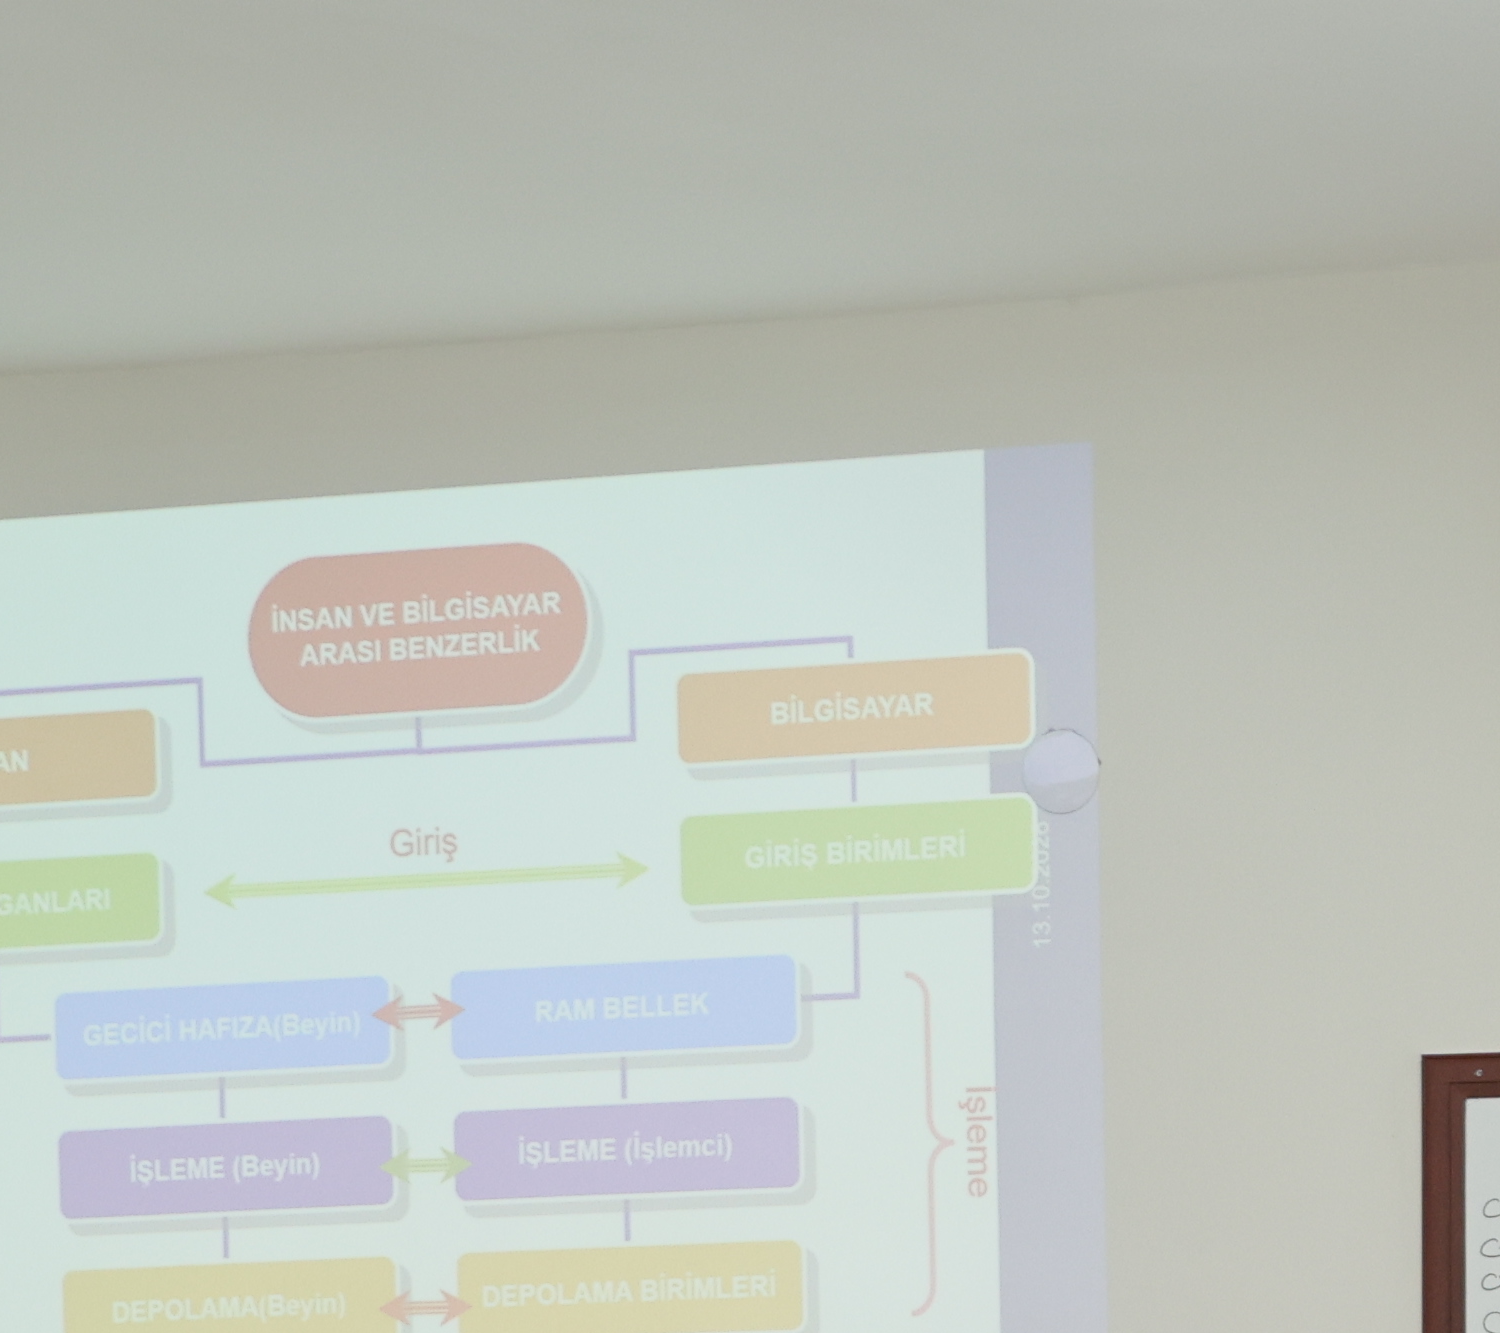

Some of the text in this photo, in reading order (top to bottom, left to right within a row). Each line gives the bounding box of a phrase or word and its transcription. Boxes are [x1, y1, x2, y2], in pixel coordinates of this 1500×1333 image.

[271, 590, 562, 634] İNSAN VE BİLGİSAYAR
[300, 628, 541, 667] ARASI BENZERLİK
[769, 692, 935, 727] BİLGİSAYAR
[389, 828, 459, 863] Giriş
[744, 829, 967, 870] GİRİŞ BİRİMLERİ
[178, 1008, 362, 1042] HAFIZA(Beyin)
[534, 992, 710, 1023] RAM BELLEK
[517, 1129, 734, 1169] İŞLEME (İşlemci)
[957, 1084, 997, 1199] İşleme
[128, 1150, 321, 1187] İŞLEME (Beyin)
[481, 1267, 777, 1310] DEPOLAMA BİRİMLERİ
[111, 1292, 347, 1325] DEPOLAMA(Beyin)
